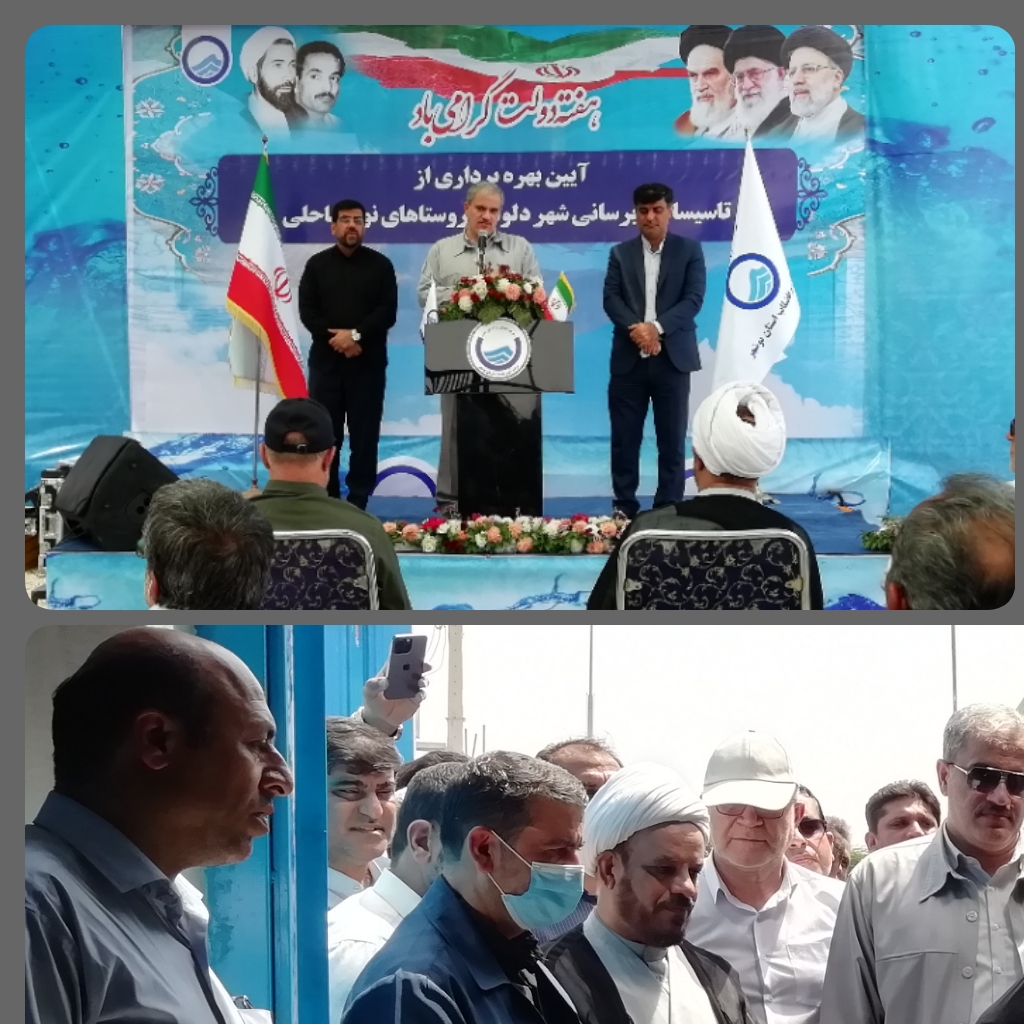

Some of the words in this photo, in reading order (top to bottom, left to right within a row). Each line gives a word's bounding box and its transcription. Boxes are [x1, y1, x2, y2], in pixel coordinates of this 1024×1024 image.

[409, 91, 435, 144] باد
[413, 165, 432, 191] از
[502, 169, 542, 190] بهره
[544, 161, 590, 189] آیین
[500, 203, 532, 228] دلو
[532, 203, 570, 228] شهر
[671, 201, 732, 225] تاسیسا
